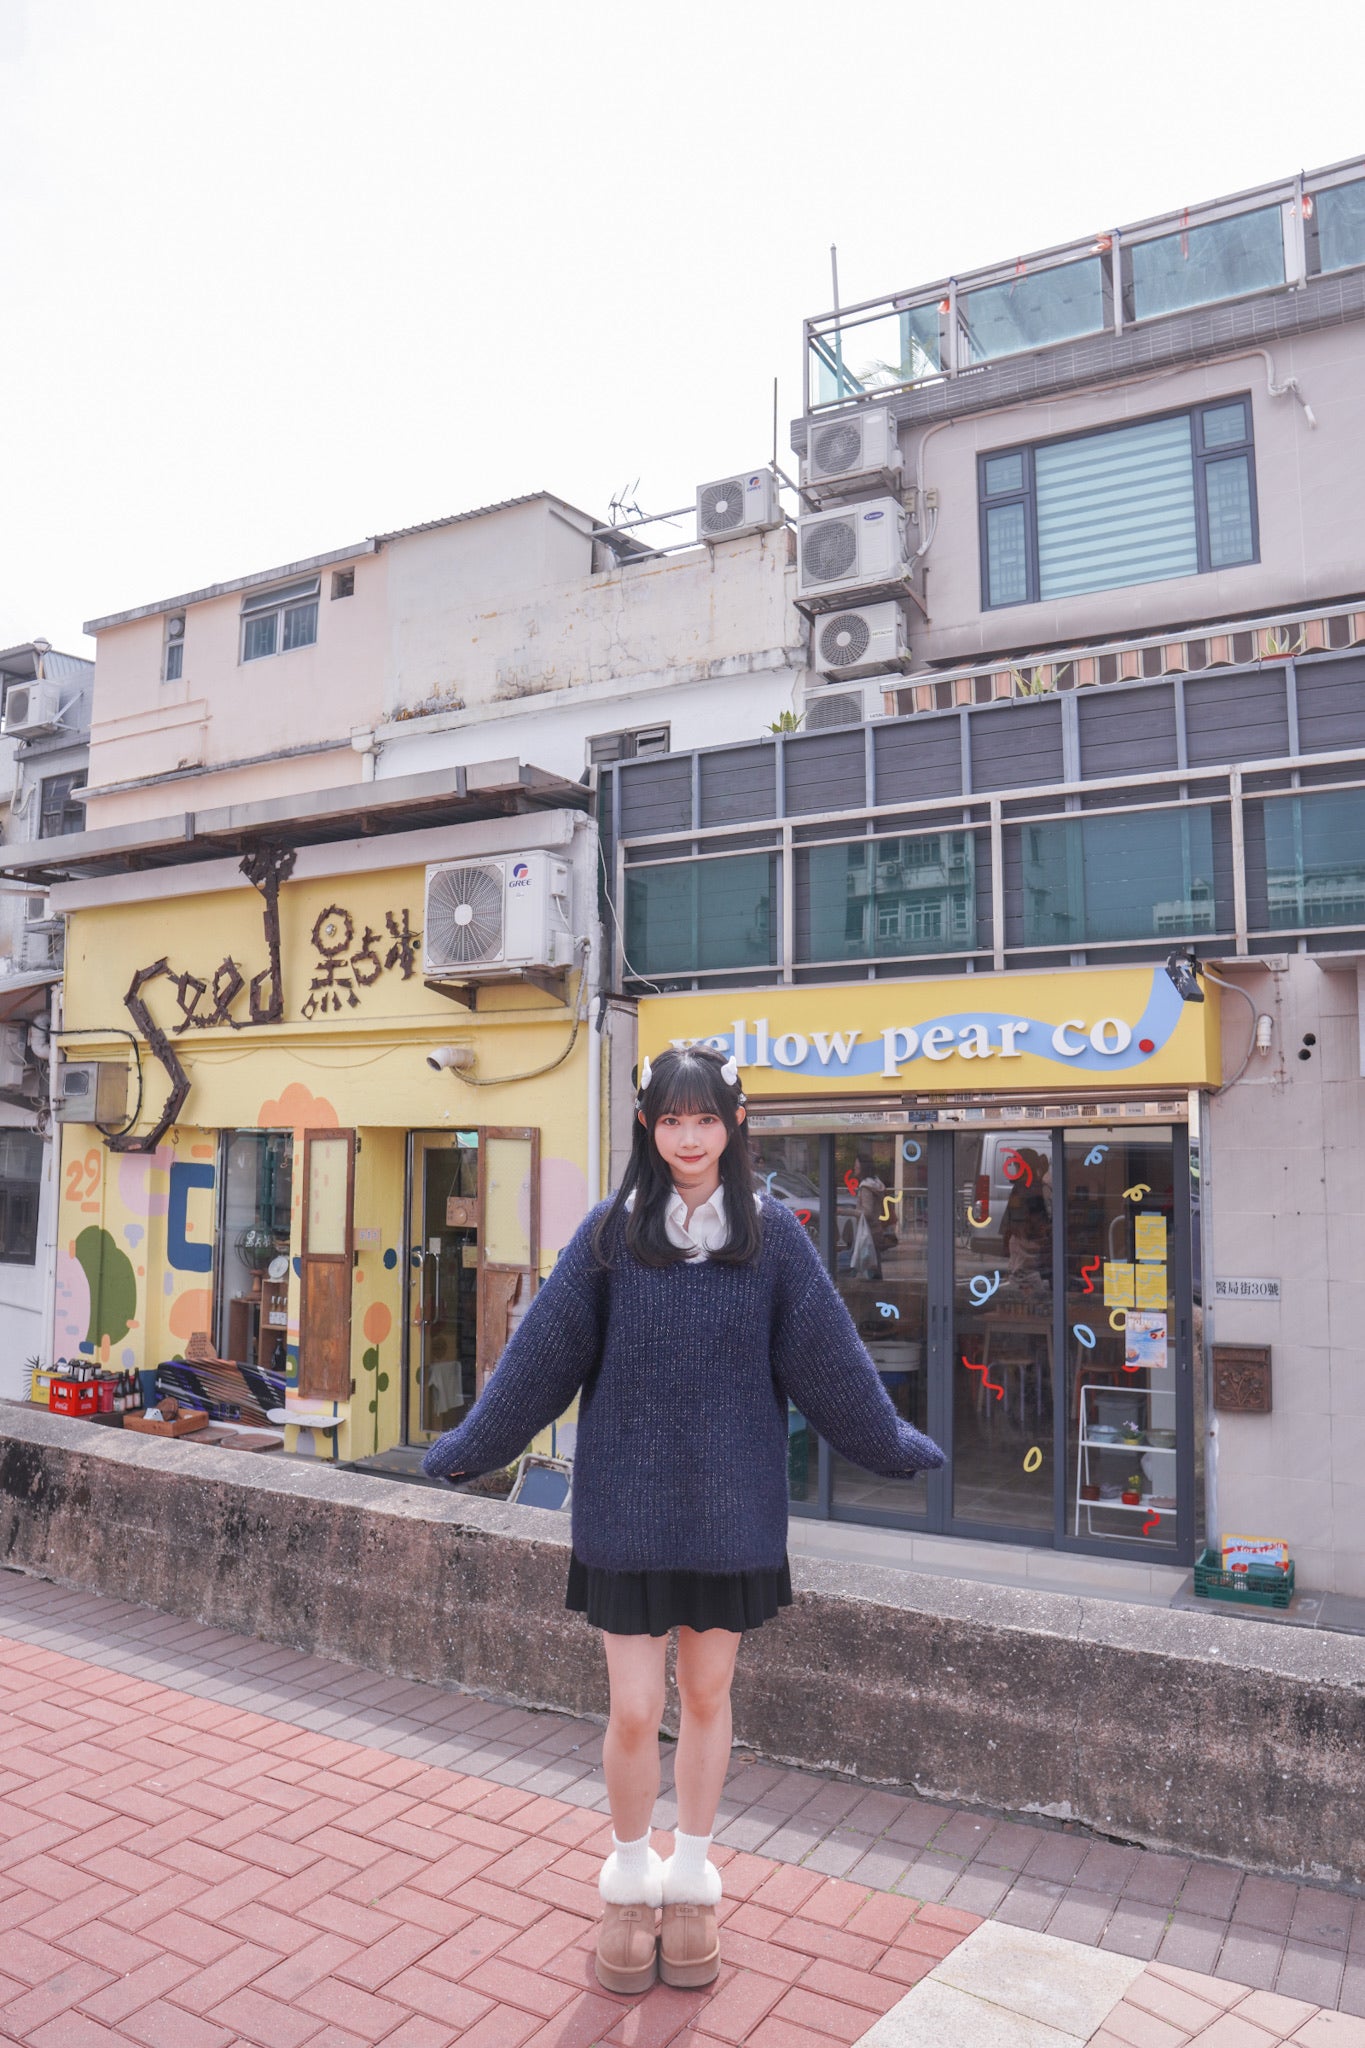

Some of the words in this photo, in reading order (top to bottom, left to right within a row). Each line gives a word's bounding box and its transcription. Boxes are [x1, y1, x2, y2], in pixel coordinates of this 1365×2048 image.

[509, 879, 532, 888] GREE
[103, 848, 297, 1153] Seed
[880, 1021, 1029, 1078] pear
[1052, 1017, 1155, 1057] co.
[65, 1149, 101, 1202] 29
[1215, 1281, 1279, 1296] 醫局街30號
